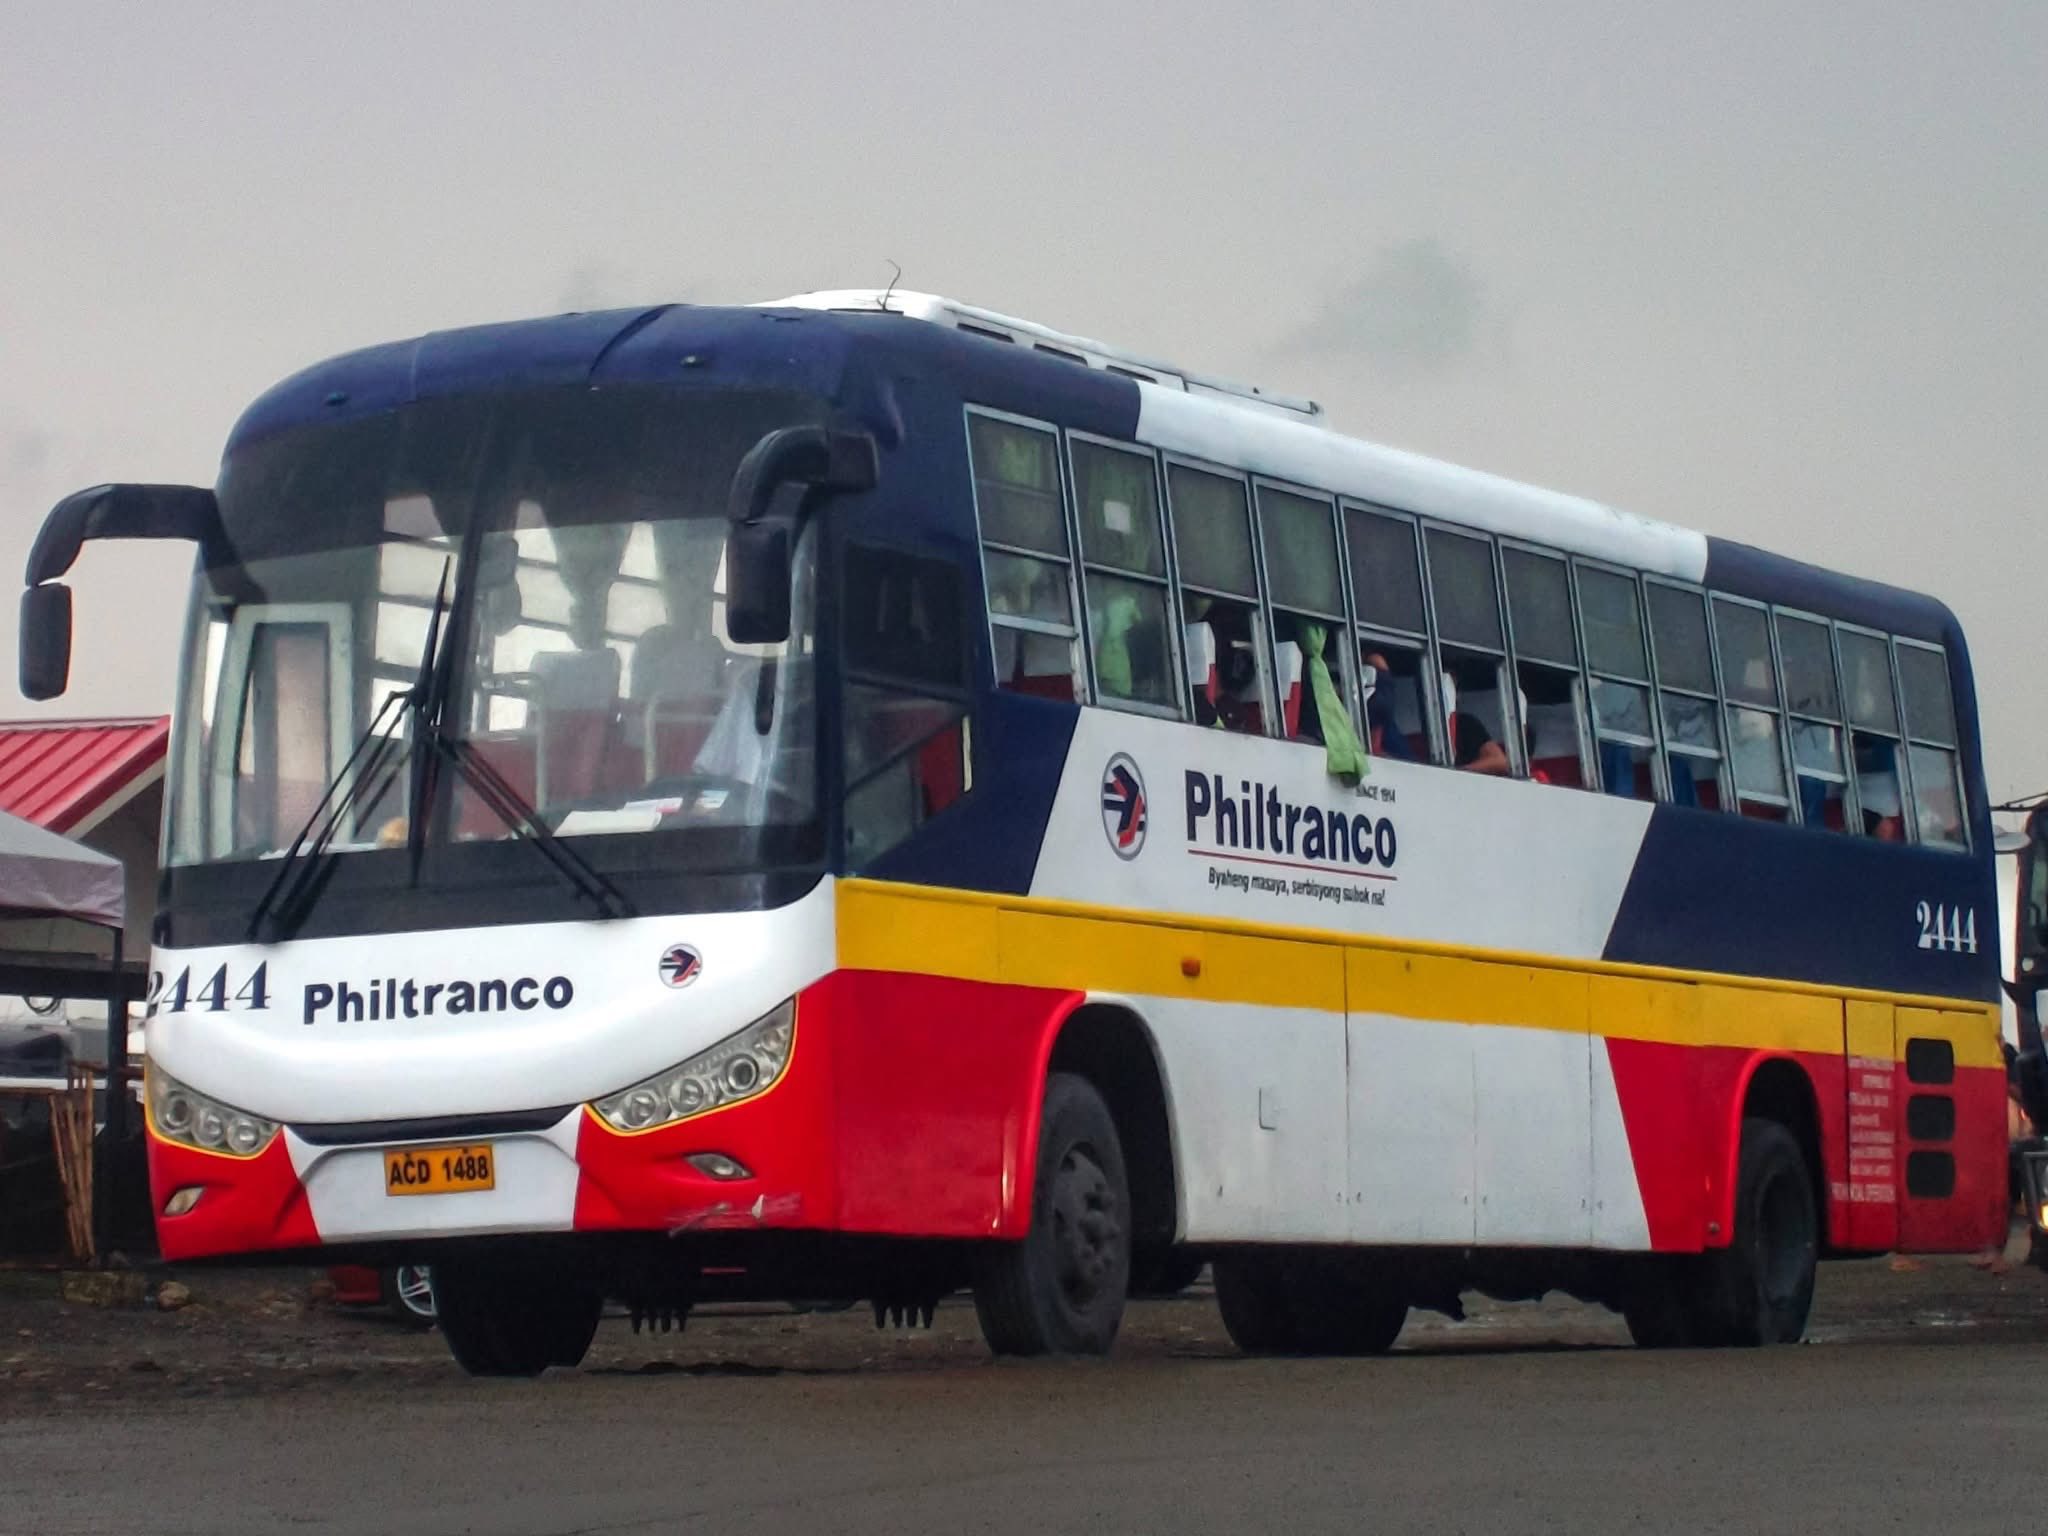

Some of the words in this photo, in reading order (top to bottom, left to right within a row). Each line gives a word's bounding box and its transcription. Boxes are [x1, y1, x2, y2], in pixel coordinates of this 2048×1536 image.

[1184, 769, 1397, 868] Philtranco
[1208, 866, 1249, 893] Byaheng
[1917, 900, 1977, 954] 2444
[145, 960, 271, 1019] 2444
[304, 976, 574, 1025] Philtranco
[390, 1159, 431, 1186] ACD
[442, 1155, 489, 1182] 1488
